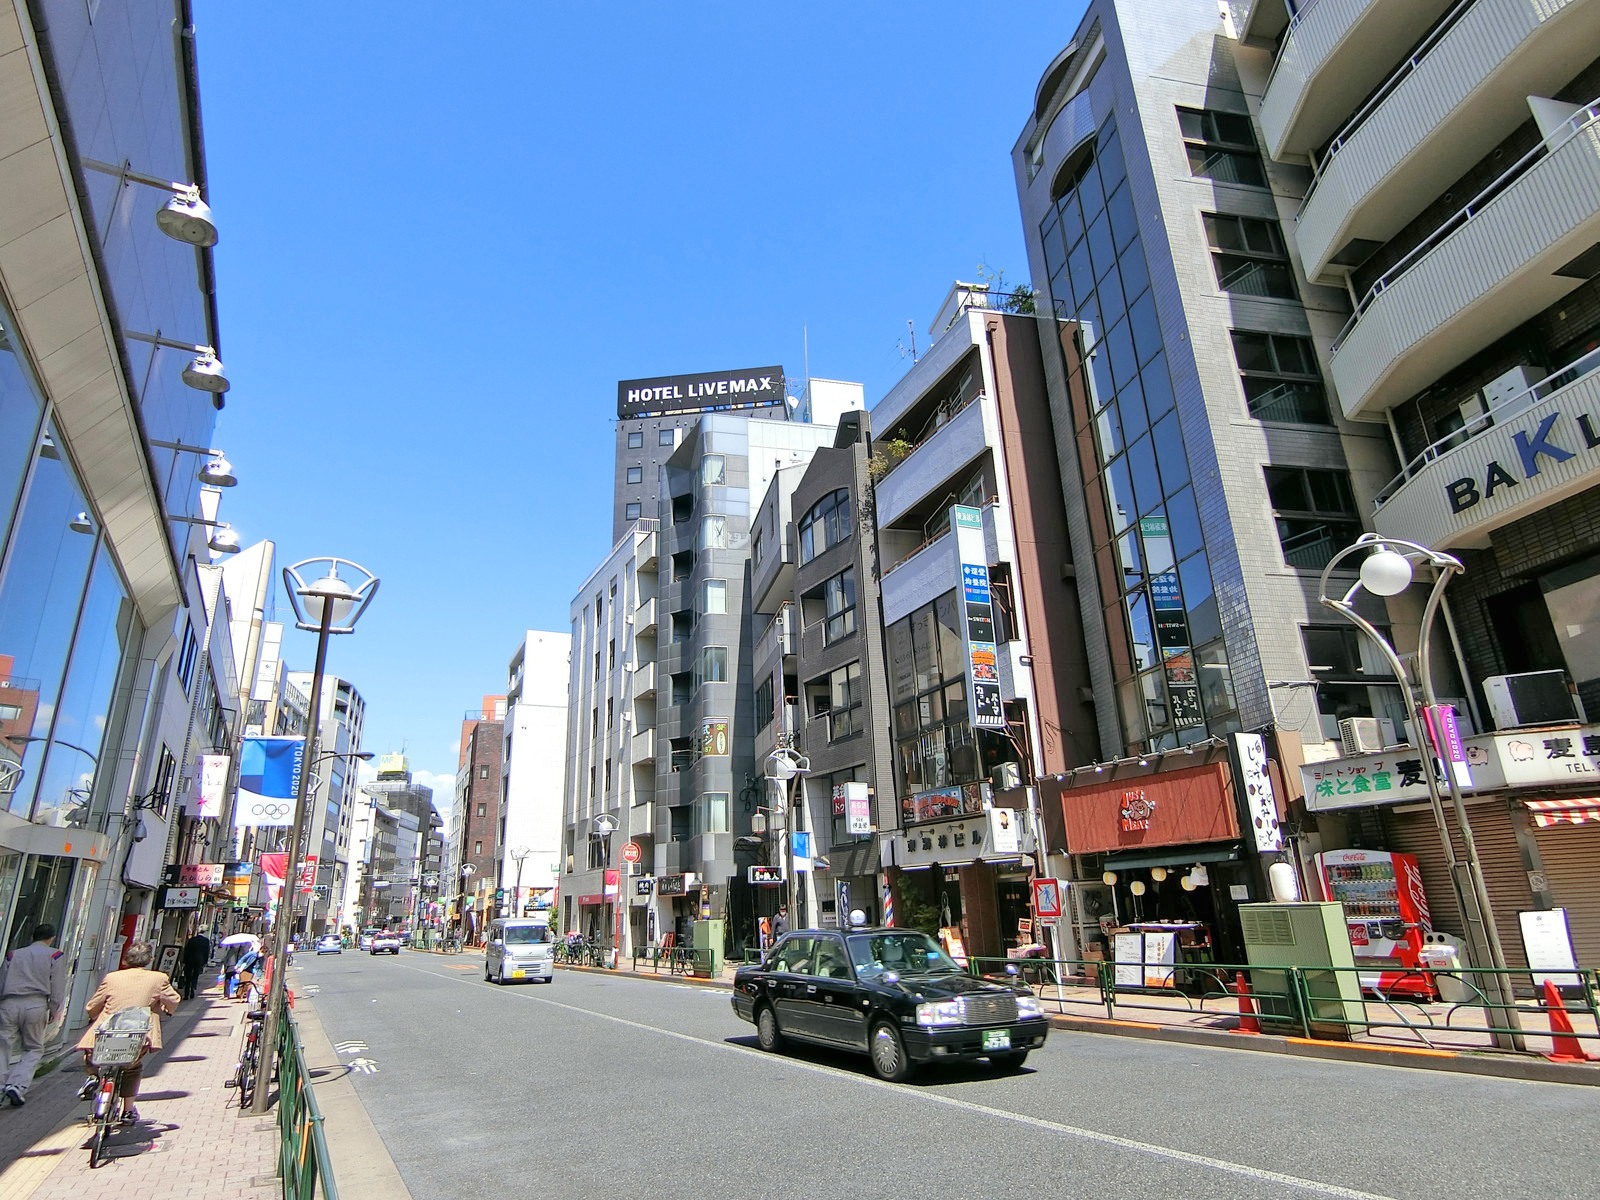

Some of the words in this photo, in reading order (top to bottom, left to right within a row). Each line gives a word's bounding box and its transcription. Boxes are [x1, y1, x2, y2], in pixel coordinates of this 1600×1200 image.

[628, 386, 683, 403] HOTEL
[975, 685, 985, 708] カット
[991, 692, 999, 715] パーマ
[1446, 713, 1456, 738] TOKYO
[293, 746, 304, 773] TOKYO
[1450, 739, 1460, 759] 2020
[1314, 762, 1383, 780] ミートショップ
[291, 775, 301, 796] 2020
[1342, 852, 1368, 861] Coca-Cola
[304, 860, 315, 886] SEIYU
